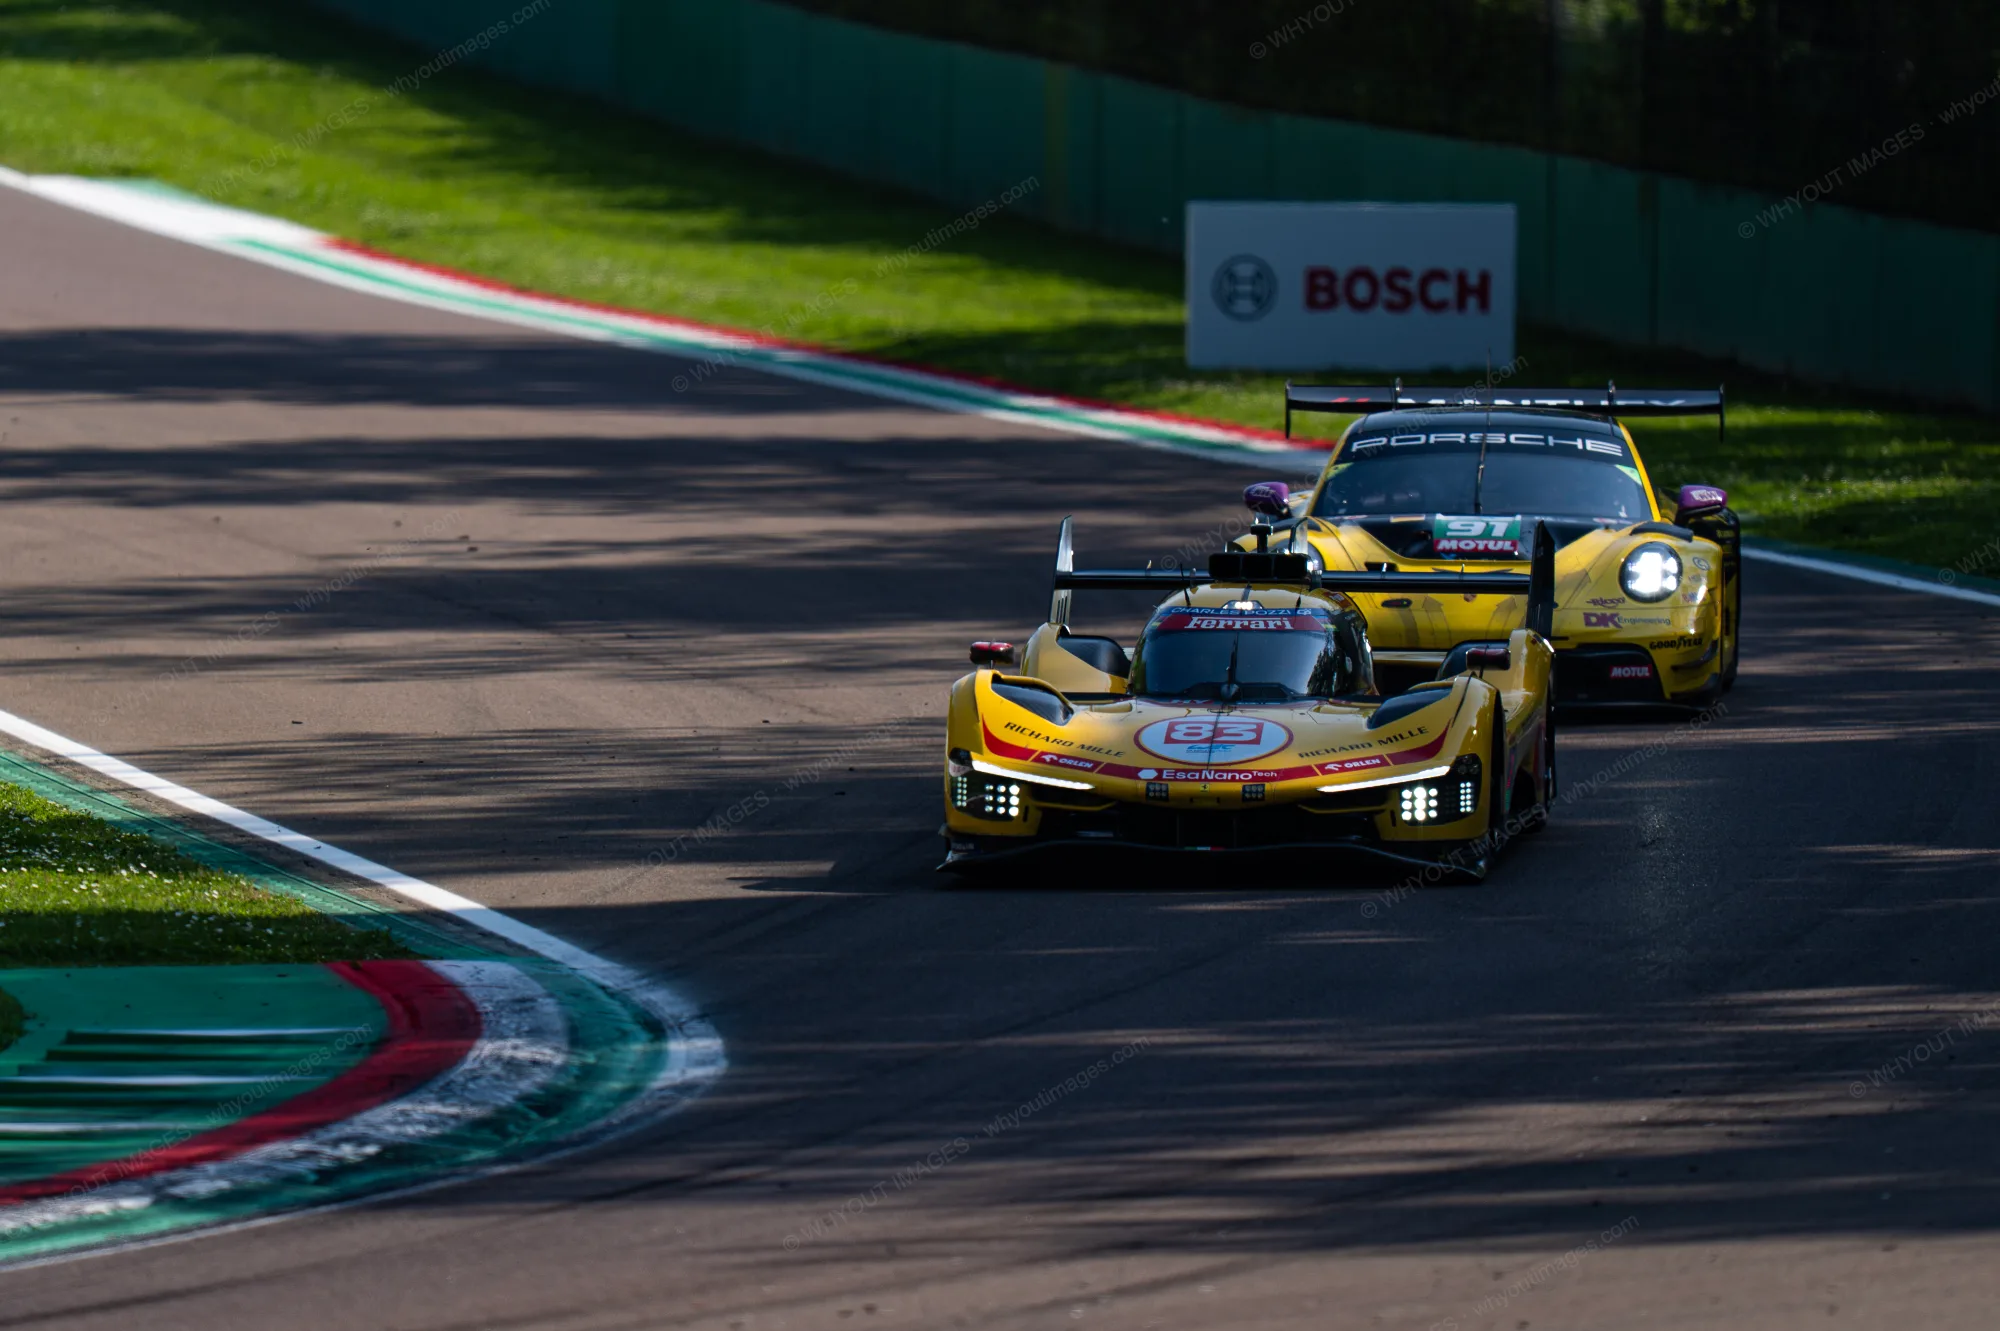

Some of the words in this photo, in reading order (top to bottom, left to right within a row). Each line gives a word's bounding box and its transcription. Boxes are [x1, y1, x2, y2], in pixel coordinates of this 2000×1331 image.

[1304, 265, 1491, 314] BOSCH
[1351, 432, 1623, 456] PORSCHE
[1446, 519, 1509, 537] 91
[1436, 539, 1517, 552] MOTUL
[1171, 606, 1239, 616] CHARLES
[1248, 608, 1290, 616] POZZI
[1184, 616, 1293, 630] Ferrari
[1583, 612, 1622, 628] DK
[1611, 666, 1650, 677] MOTUL
[1004, 721, 1074, 748] RICHARD
[1077, 743, 1126, 758] MILLE
[1170, 723, 1256, 741] 83
[1298, 741, 1373, 758] RICHARD
[1377, 726, 1430, 746] MILLE
[1057, 757, 1093, 769] ORLEN
[1344, 757, 1381, 768] ORLEN
